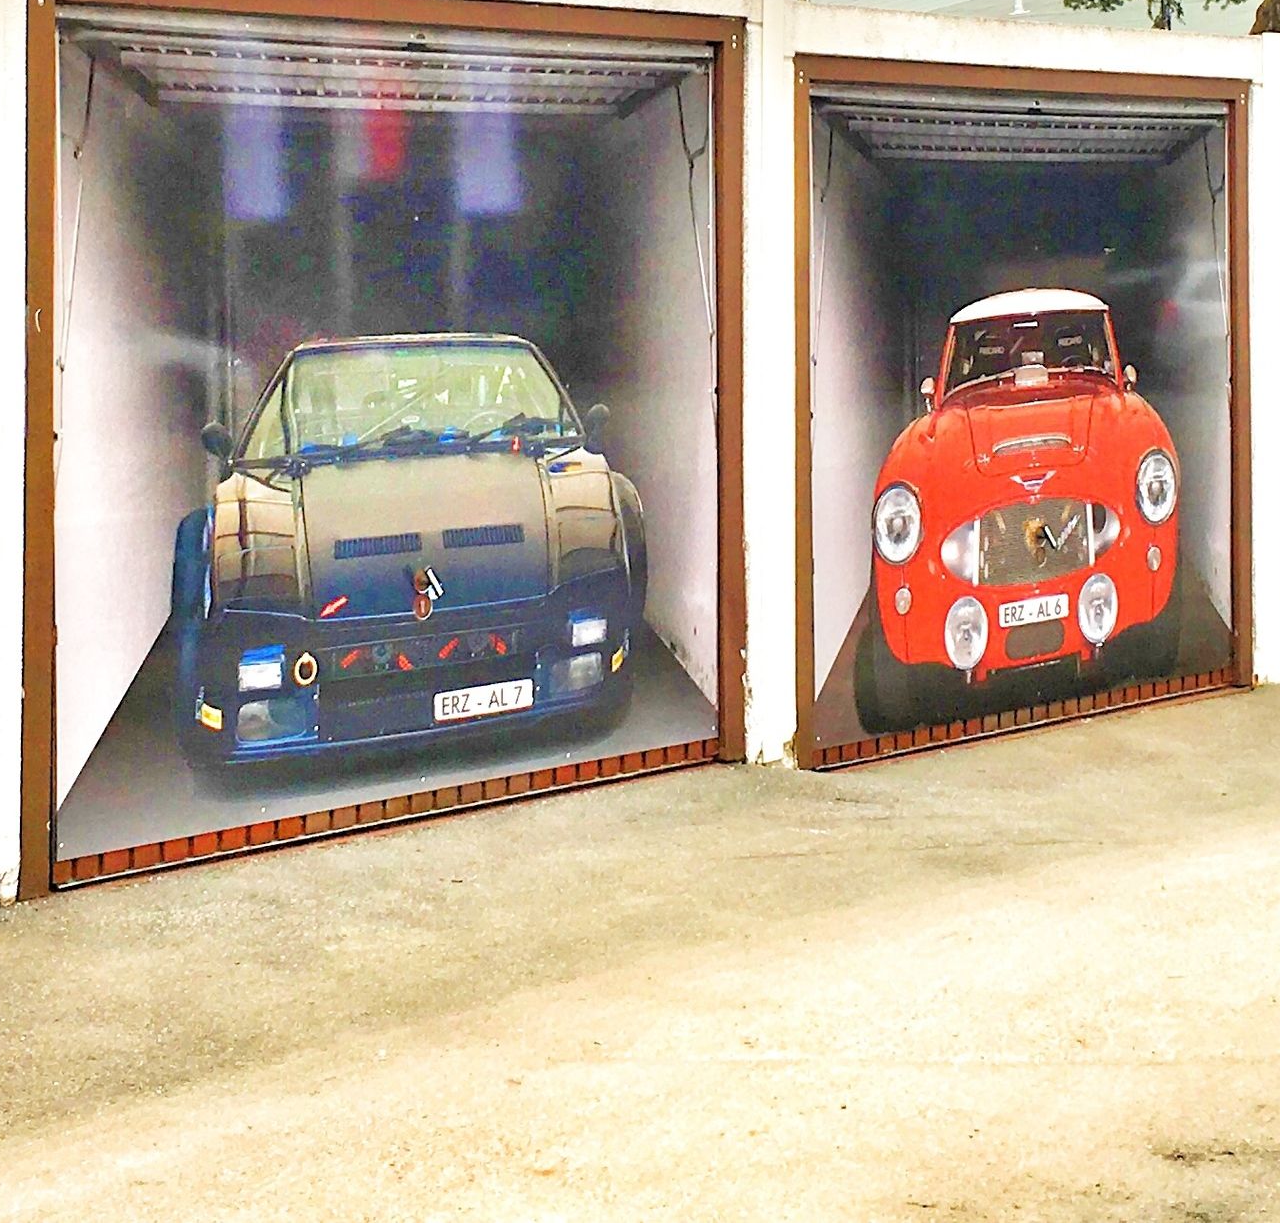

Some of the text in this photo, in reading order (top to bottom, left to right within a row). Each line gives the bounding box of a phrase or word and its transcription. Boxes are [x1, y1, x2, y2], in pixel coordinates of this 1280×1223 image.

[1004, 604, 1025, 624] ERZ
[1037, 600, 1051, 618] AL
[1054, 598, 1062, 616] 6
[442, 694, 470, 715] ERZ
[488, 688, 508, 708] AL
[514, 686, 523, 705] 7
